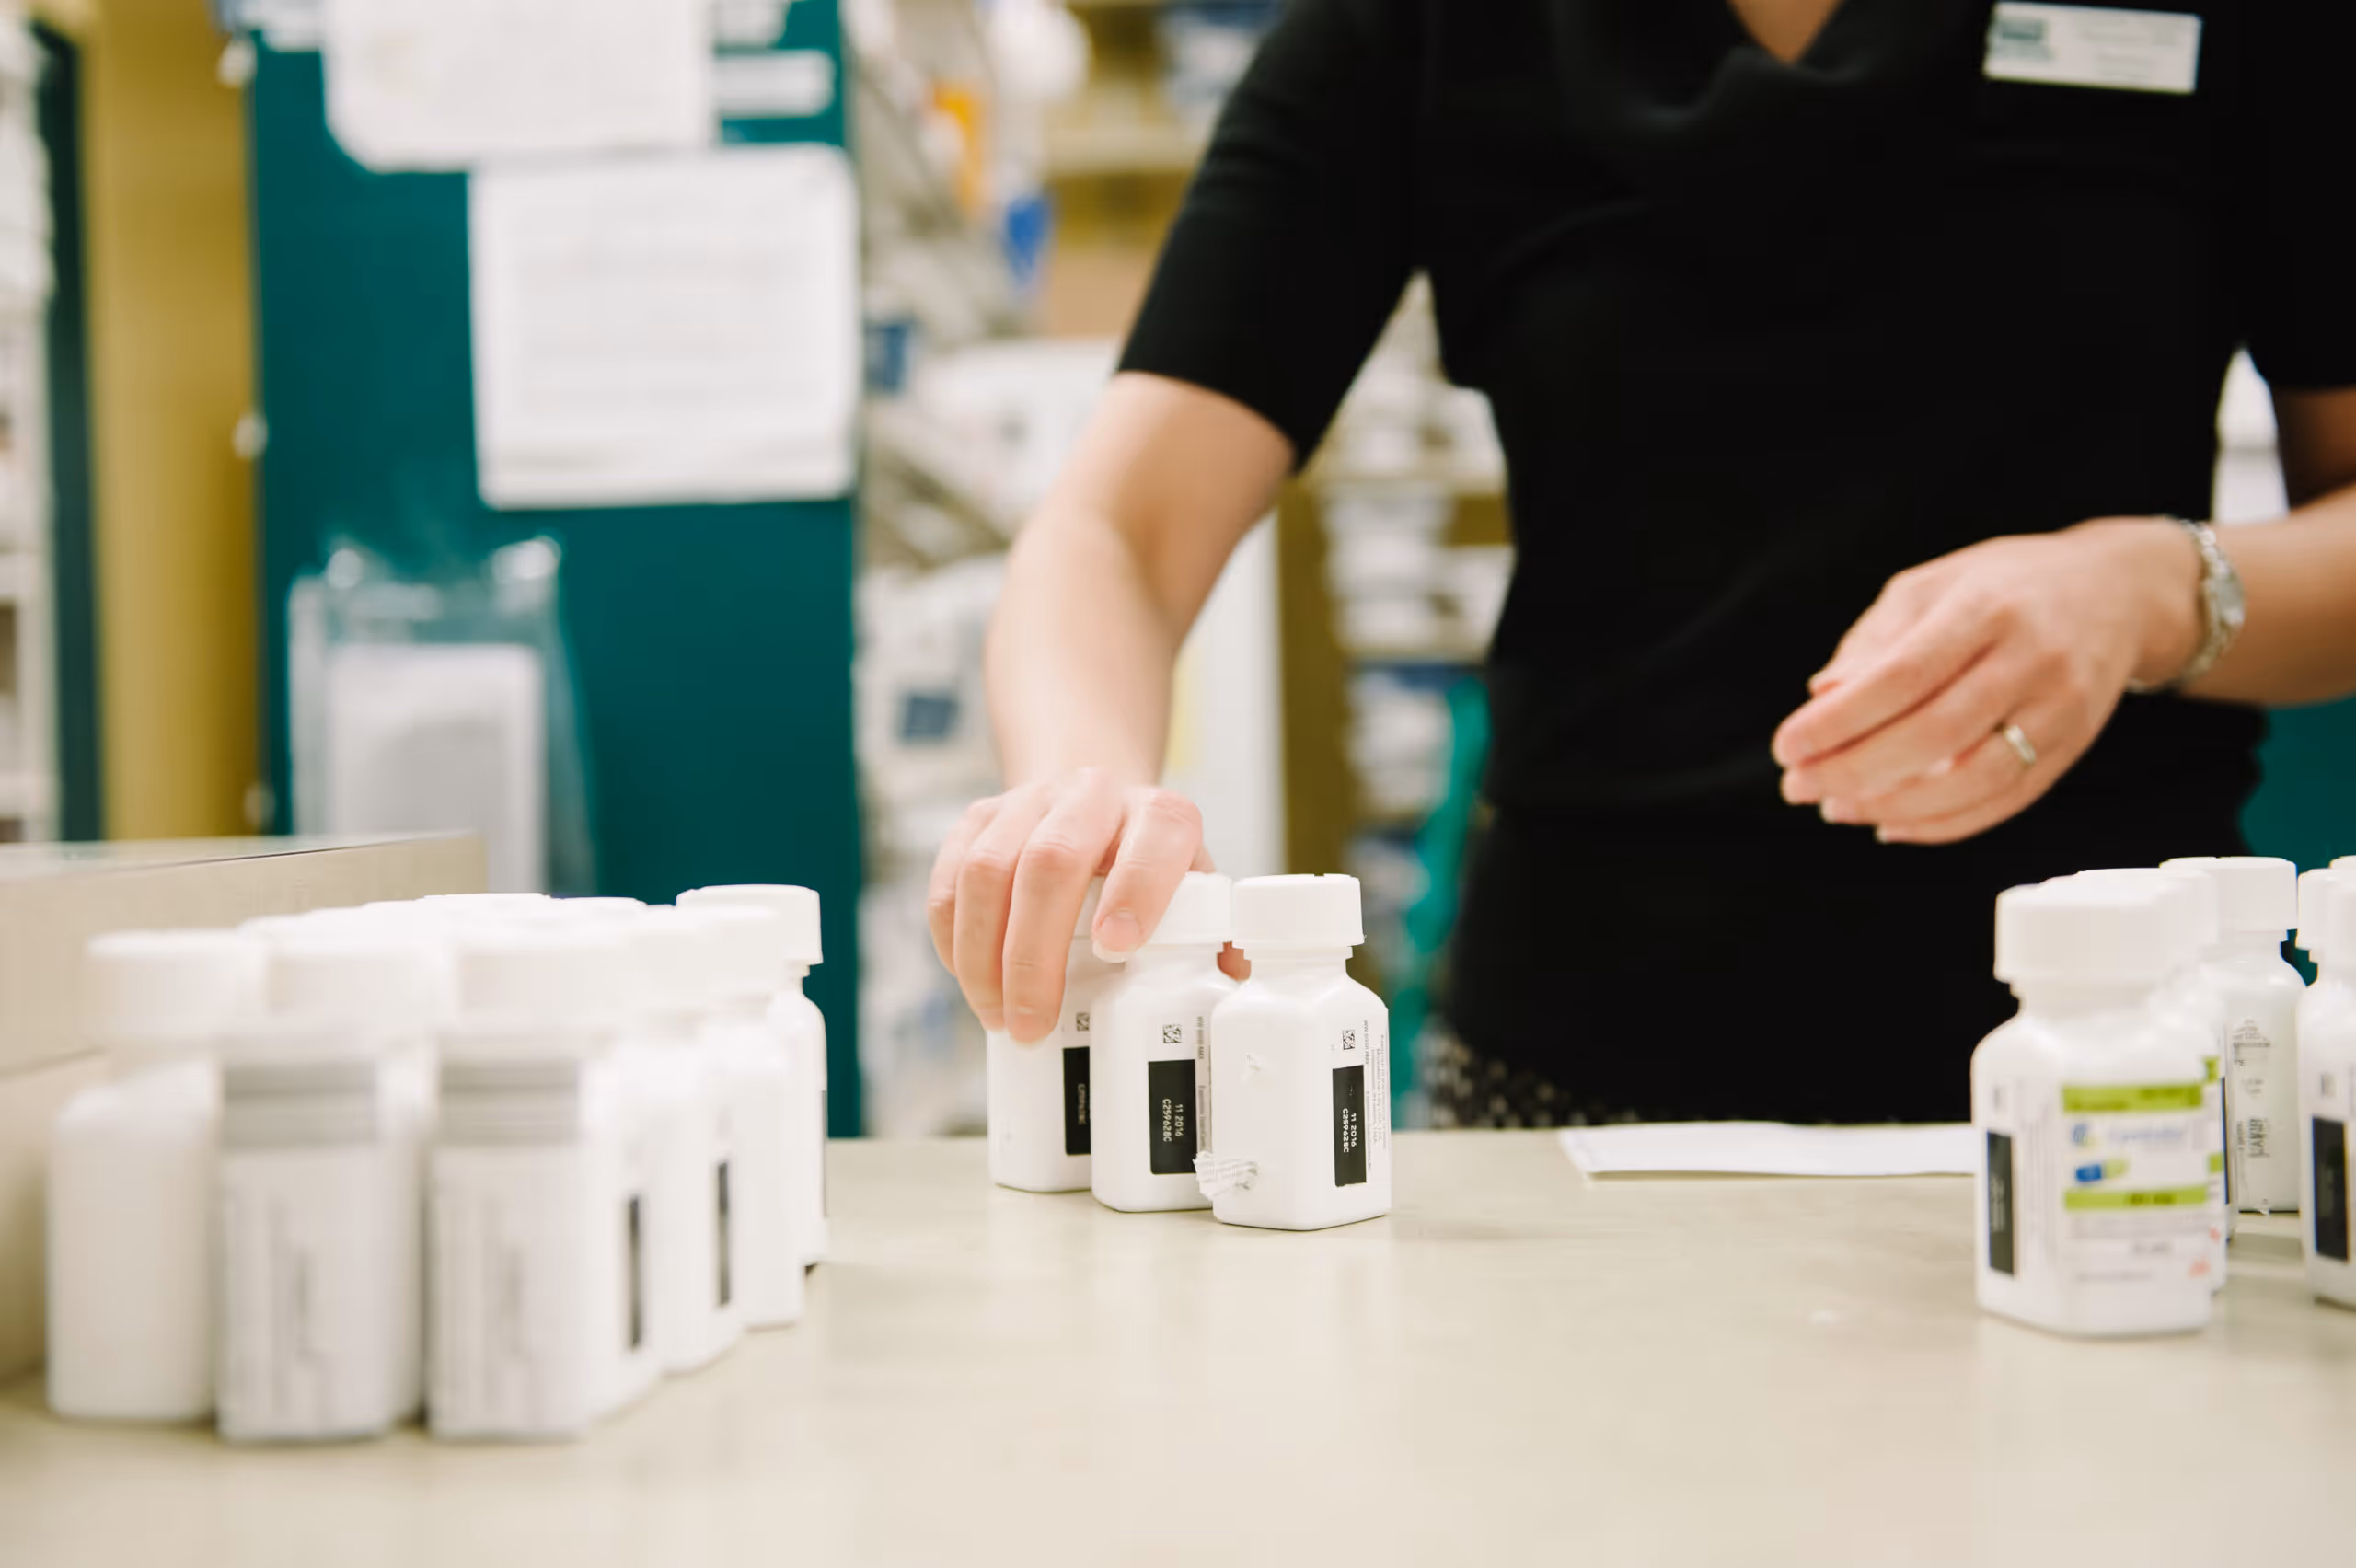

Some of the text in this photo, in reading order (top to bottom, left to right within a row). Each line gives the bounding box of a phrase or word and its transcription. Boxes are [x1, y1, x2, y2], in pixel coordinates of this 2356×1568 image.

[1162, 1099, 1172, 1142] C259628C
[1175, 1104, 1184, 1137] 11 2016
[1350, 1113, 1357, 1122] 11
